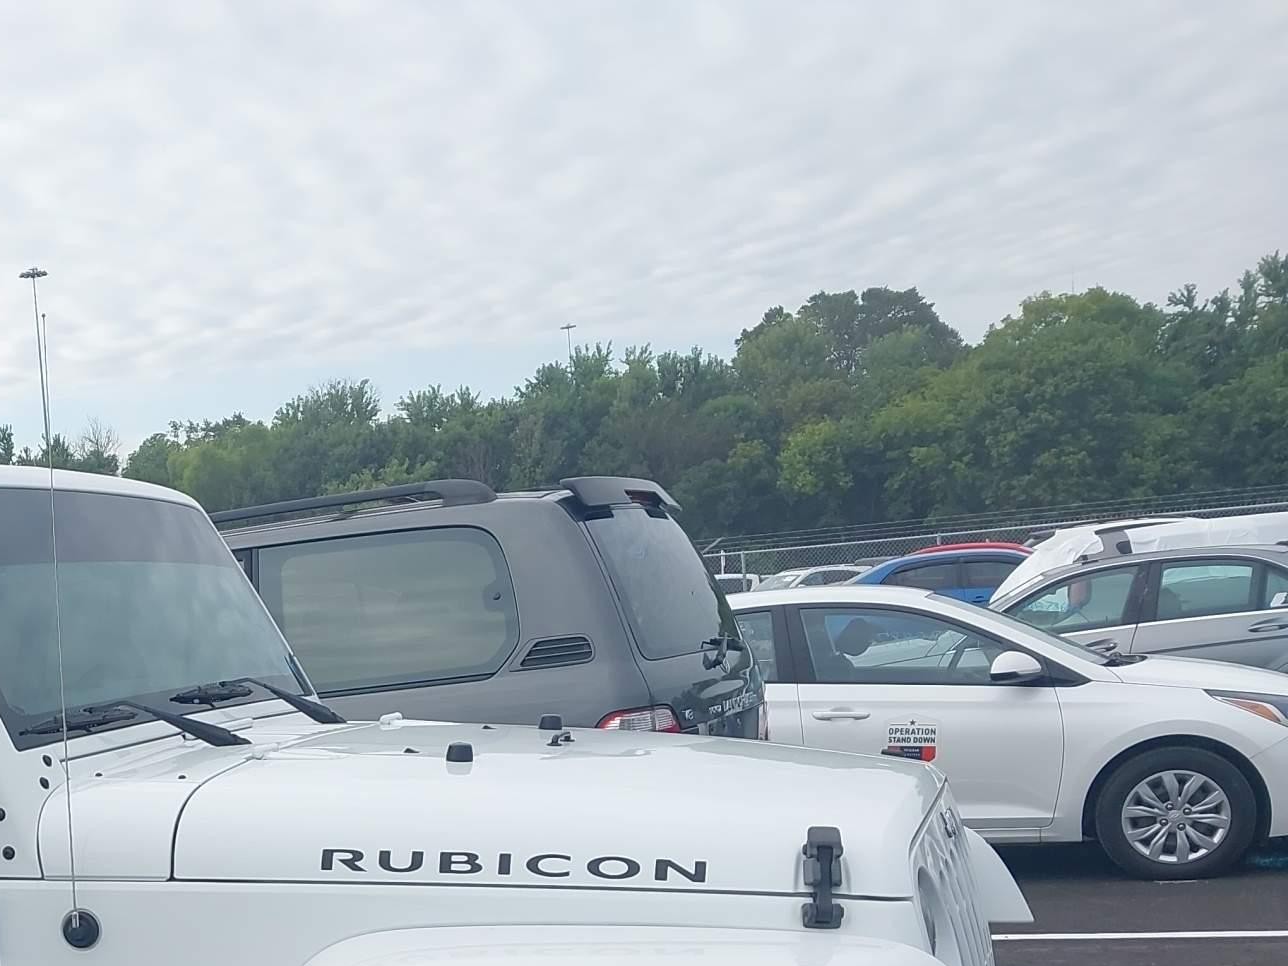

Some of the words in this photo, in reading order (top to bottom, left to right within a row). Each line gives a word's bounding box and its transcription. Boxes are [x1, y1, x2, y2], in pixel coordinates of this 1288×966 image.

[888, 727, 937, 736] OPERATION
[888, 736, 912, 744] STAND
[913, 736, 936, 744] DOWN
[319, 848, 708, 883] RUBICON
